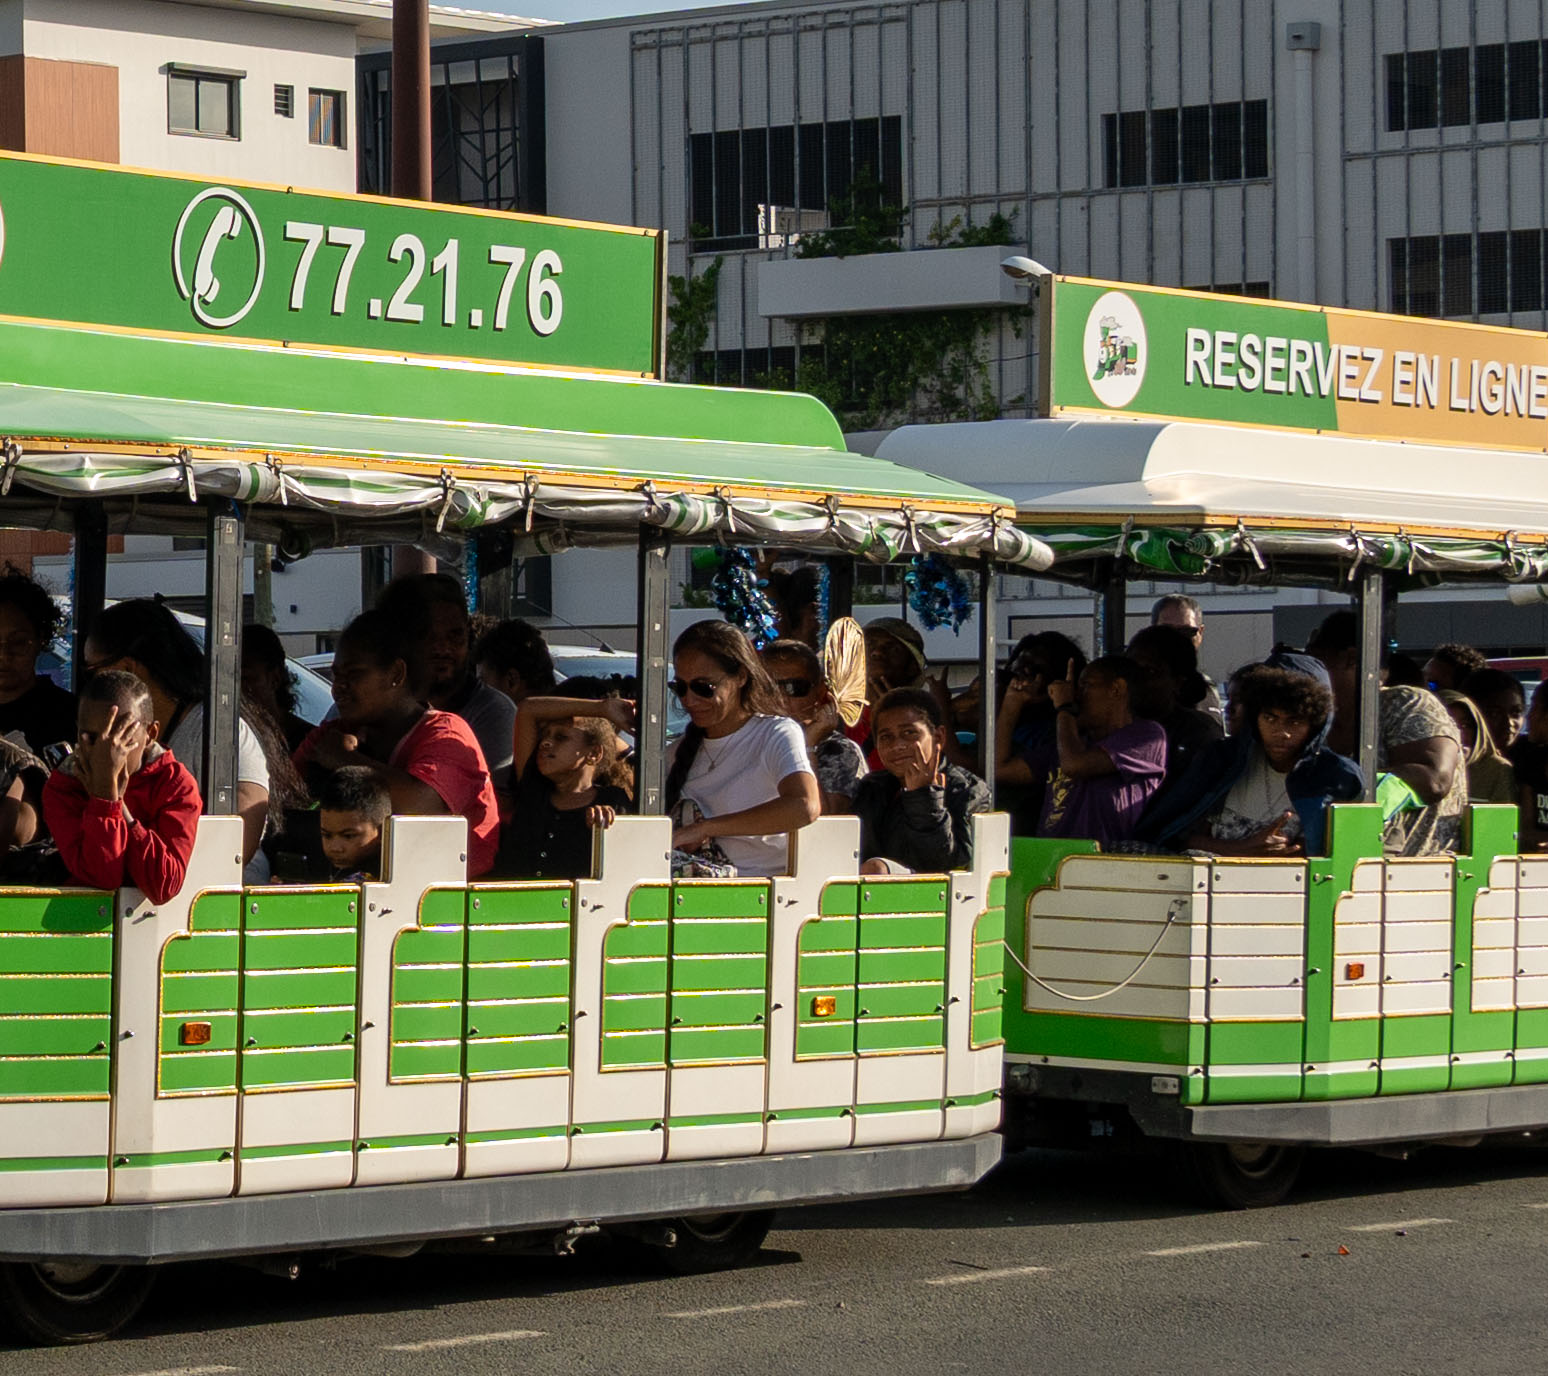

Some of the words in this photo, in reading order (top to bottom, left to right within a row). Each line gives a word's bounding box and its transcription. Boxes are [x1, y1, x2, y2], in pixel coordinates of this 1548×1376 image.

[284, 221, 563, 335] 77.21.76
[1185, 327, 1384, 403] RESERVEZ
[1393, 350, 1440, 409] EN
